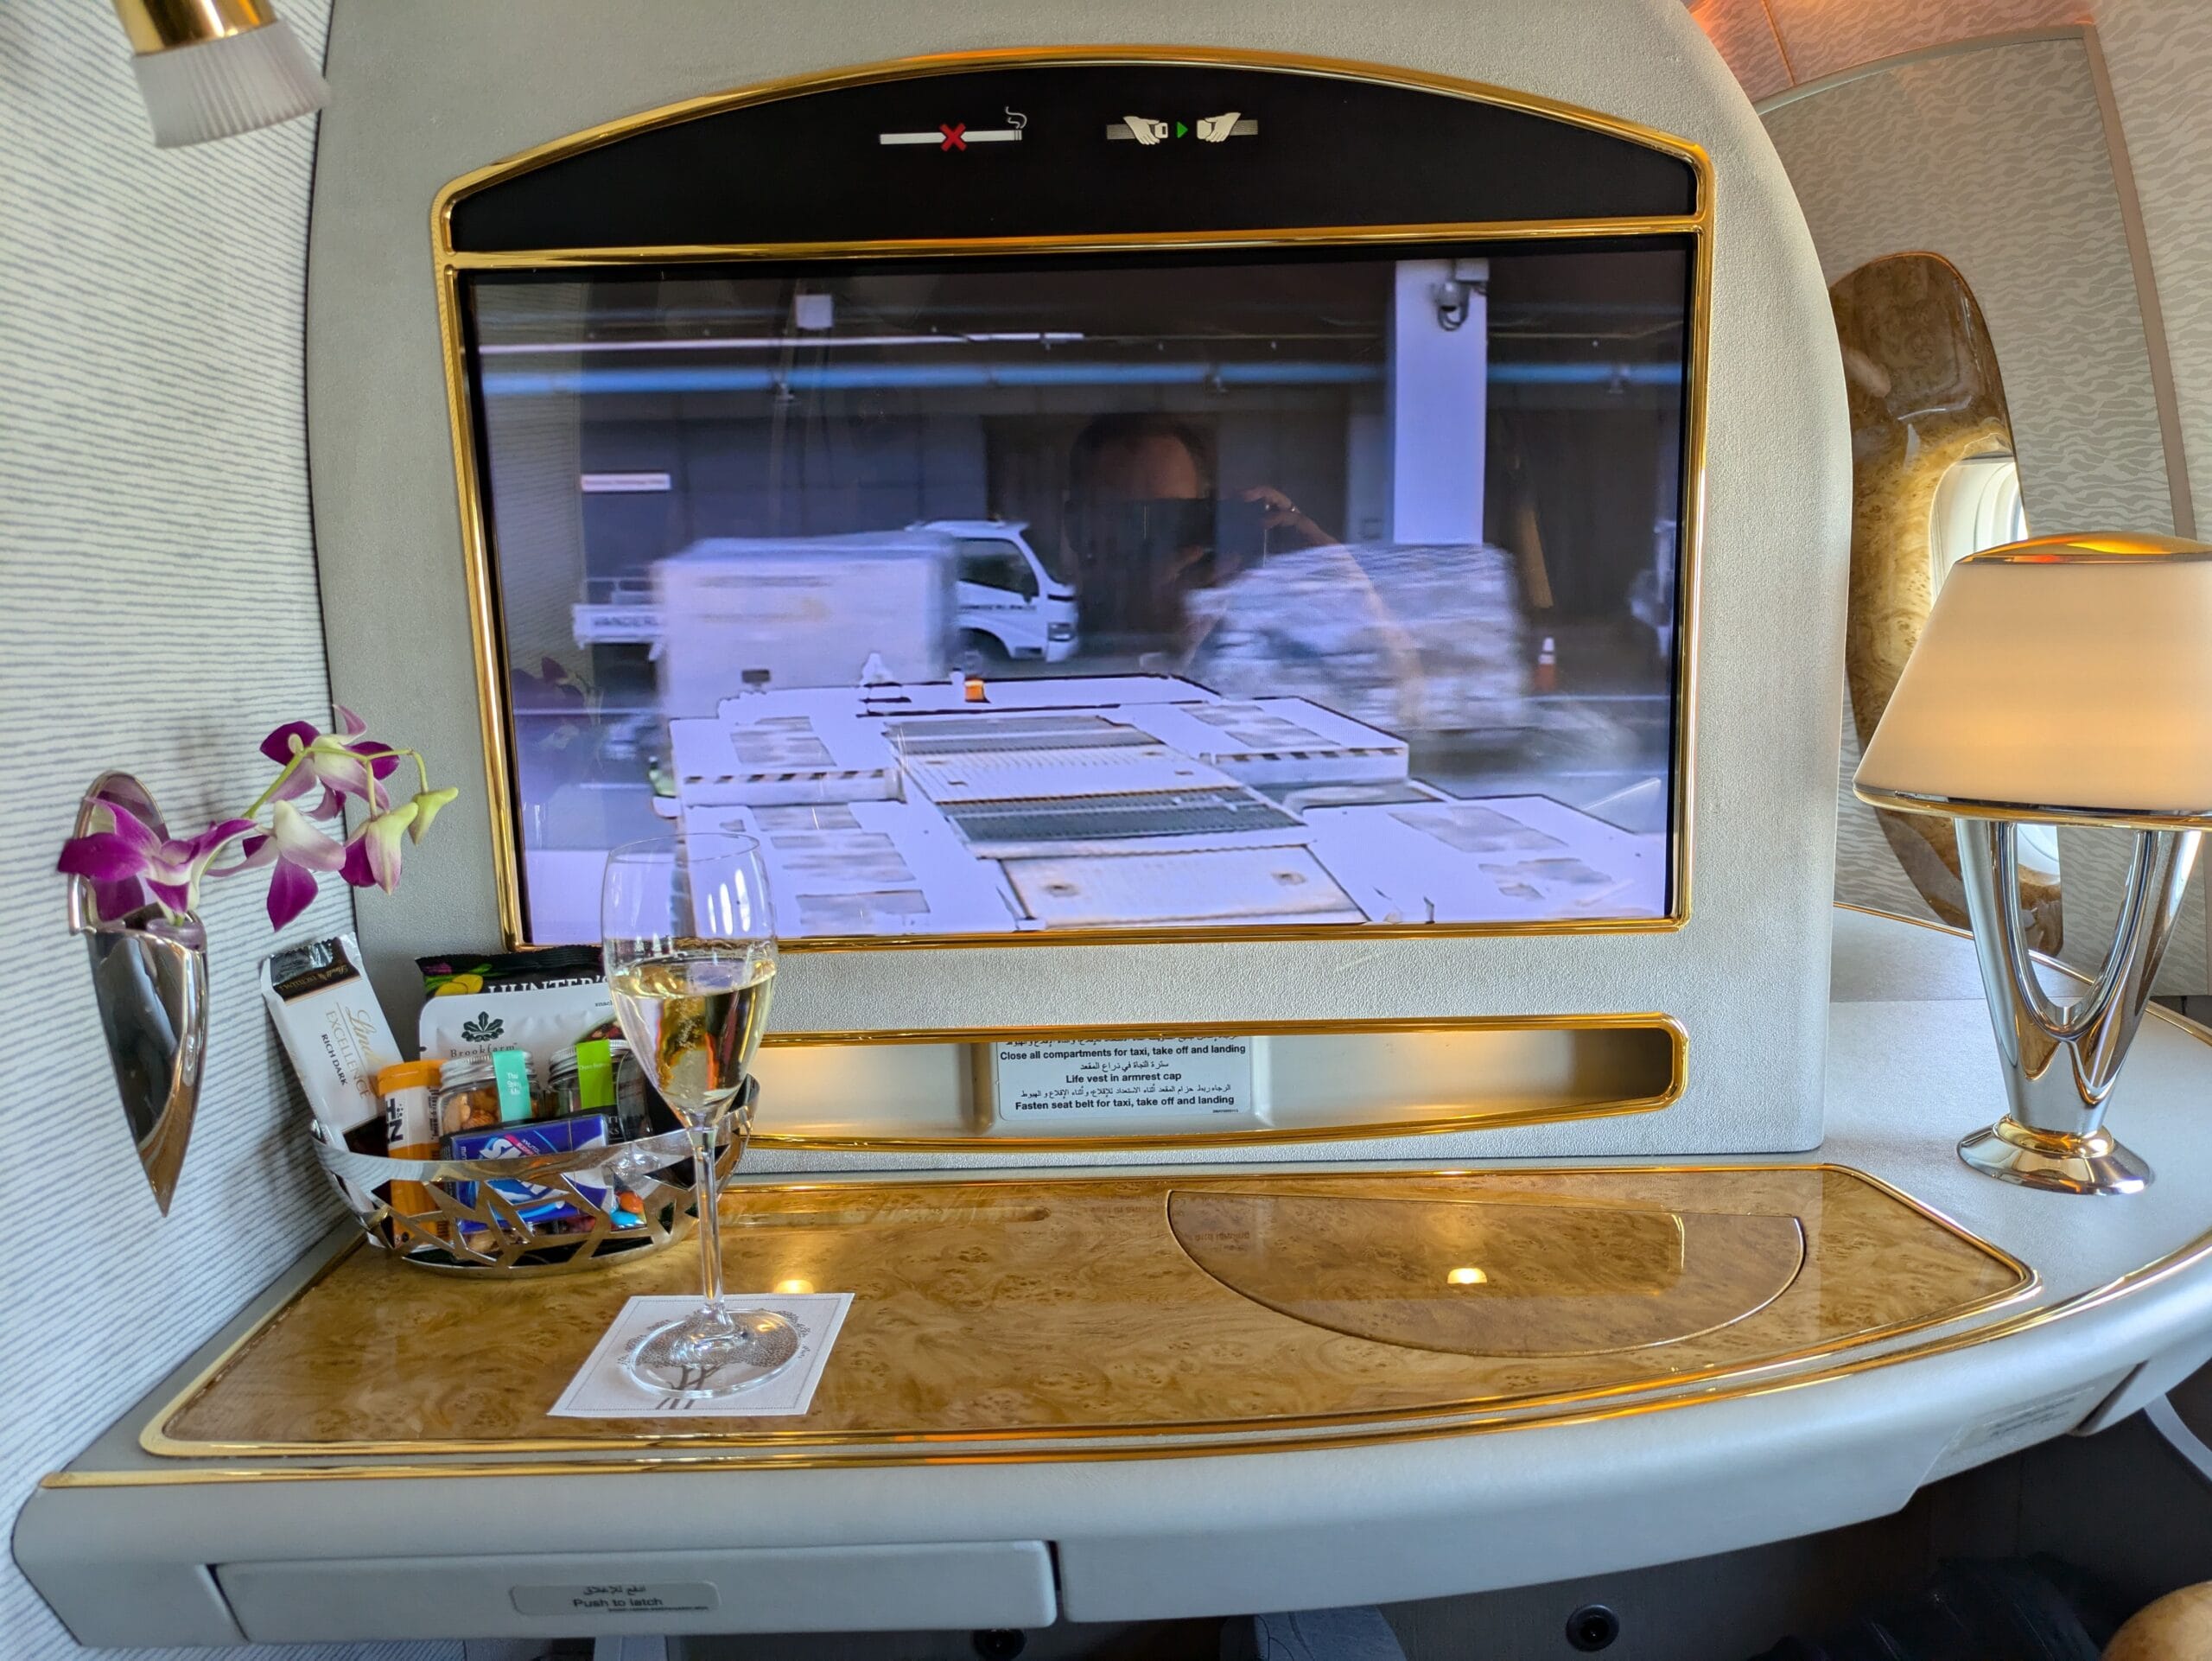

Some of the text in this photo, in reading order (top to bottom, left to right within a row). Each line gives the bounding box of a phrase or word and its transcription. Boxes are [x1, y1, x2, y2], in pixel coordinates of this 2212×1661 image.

[487, 974, 608, 994] HUNTER'
[321, 1033, 348, 1086] RICH DARK
[326, 1010, 371, 1099] EXCELLENCE
[1000, 1044, 1246, 1060] Close all compartments for taxi, take off and landing
[1110, 1073, 1119, 1082] in
[1122, 1072, 1161, 1081] armrest
[1163, 1072, 1182, 1081] cap
[1015, 1101, 1049, 1110] Fasten
[1075, 1099, 1094, 1108] belt
[1113, 1098, 1134, 1108] taxi,
[1136, 1098, 1159, 1106] take
[1161, 1097, 1174, 1105] off
[1177, 1096, 1196, 1104] and
[1198, 1095, 1235, 1105] landing
[573, 1599, 608, 1607] Push
[630, 1597, 663, 1607] latch
